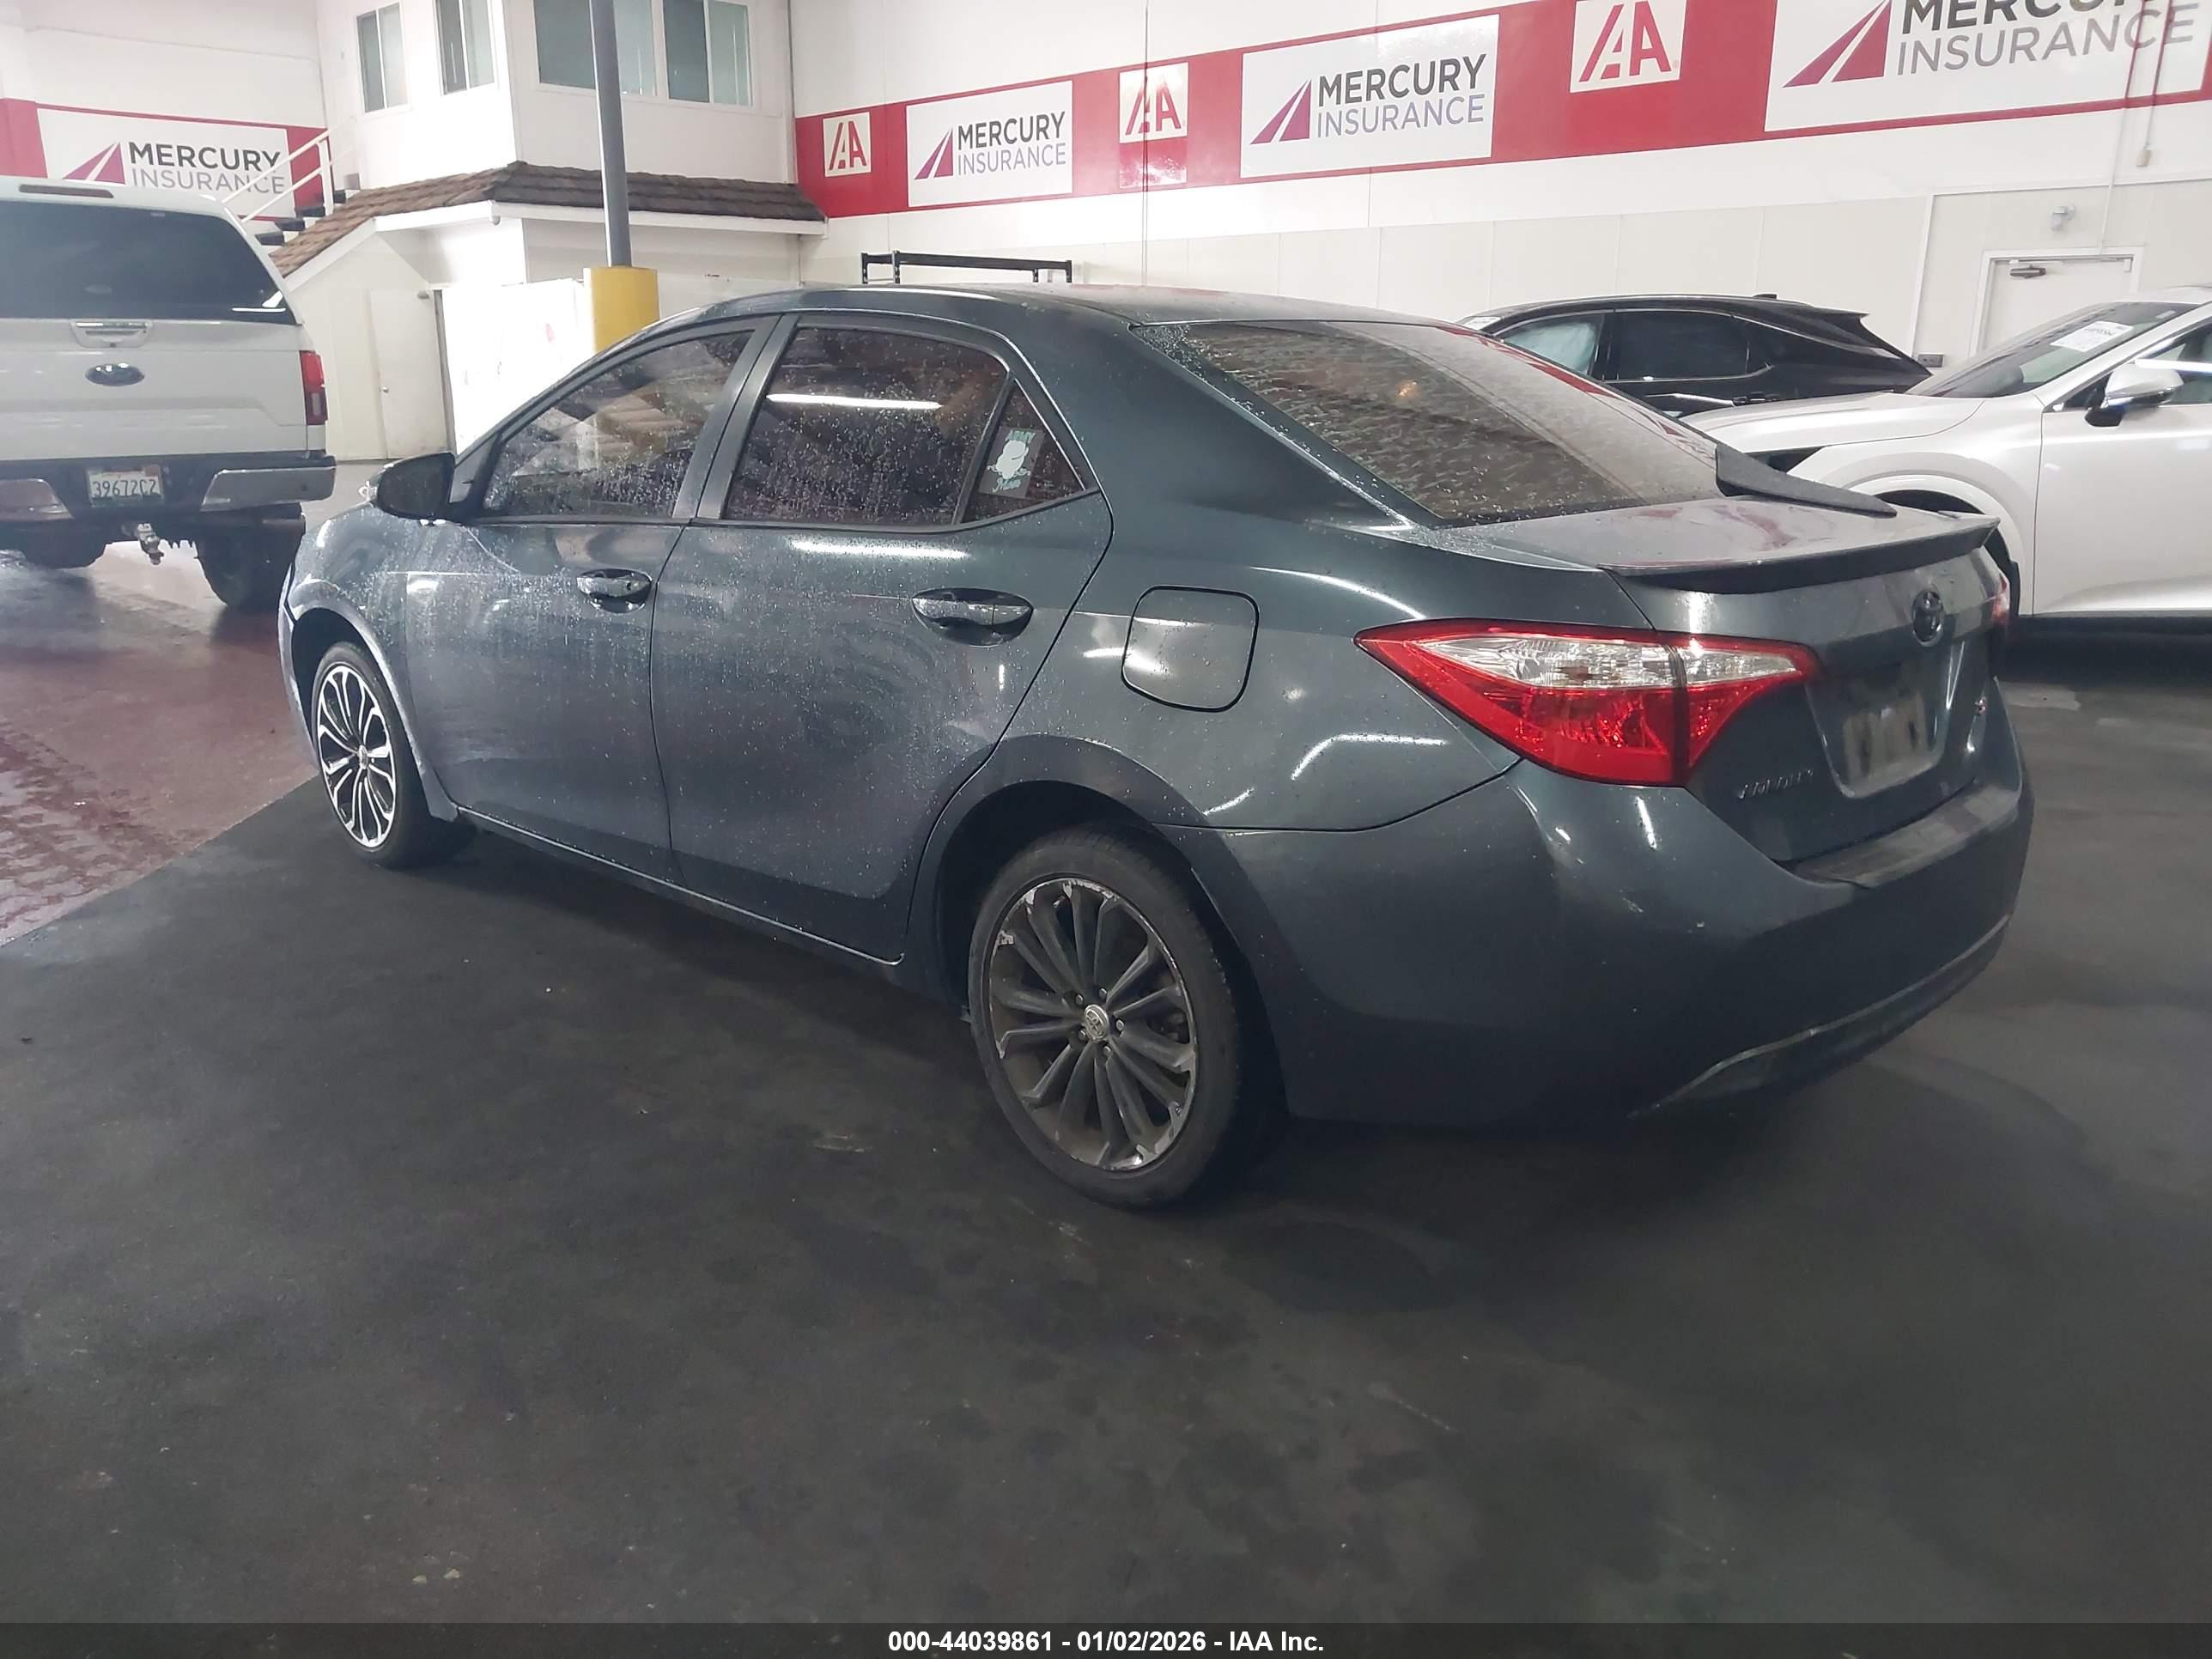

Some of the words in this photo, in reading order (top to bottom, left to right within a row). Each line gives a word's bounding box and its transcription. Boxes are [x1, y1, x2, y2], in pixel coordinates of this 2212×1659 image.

[1898, 3, 2199, 76] INSURANCE
[1318, 53, 1487, 107] MERCURY
[957, 111, 1066, 151] MERCURY
[1317, 94, 1486, 138] INSURANCE
[129, 141, 281, 172] MERCURY
[957, 142, 1066, 176] INSURANCE
[131, 168, 285, 195] INSURANCE
[92, 478, 161, 497] 39672C2
